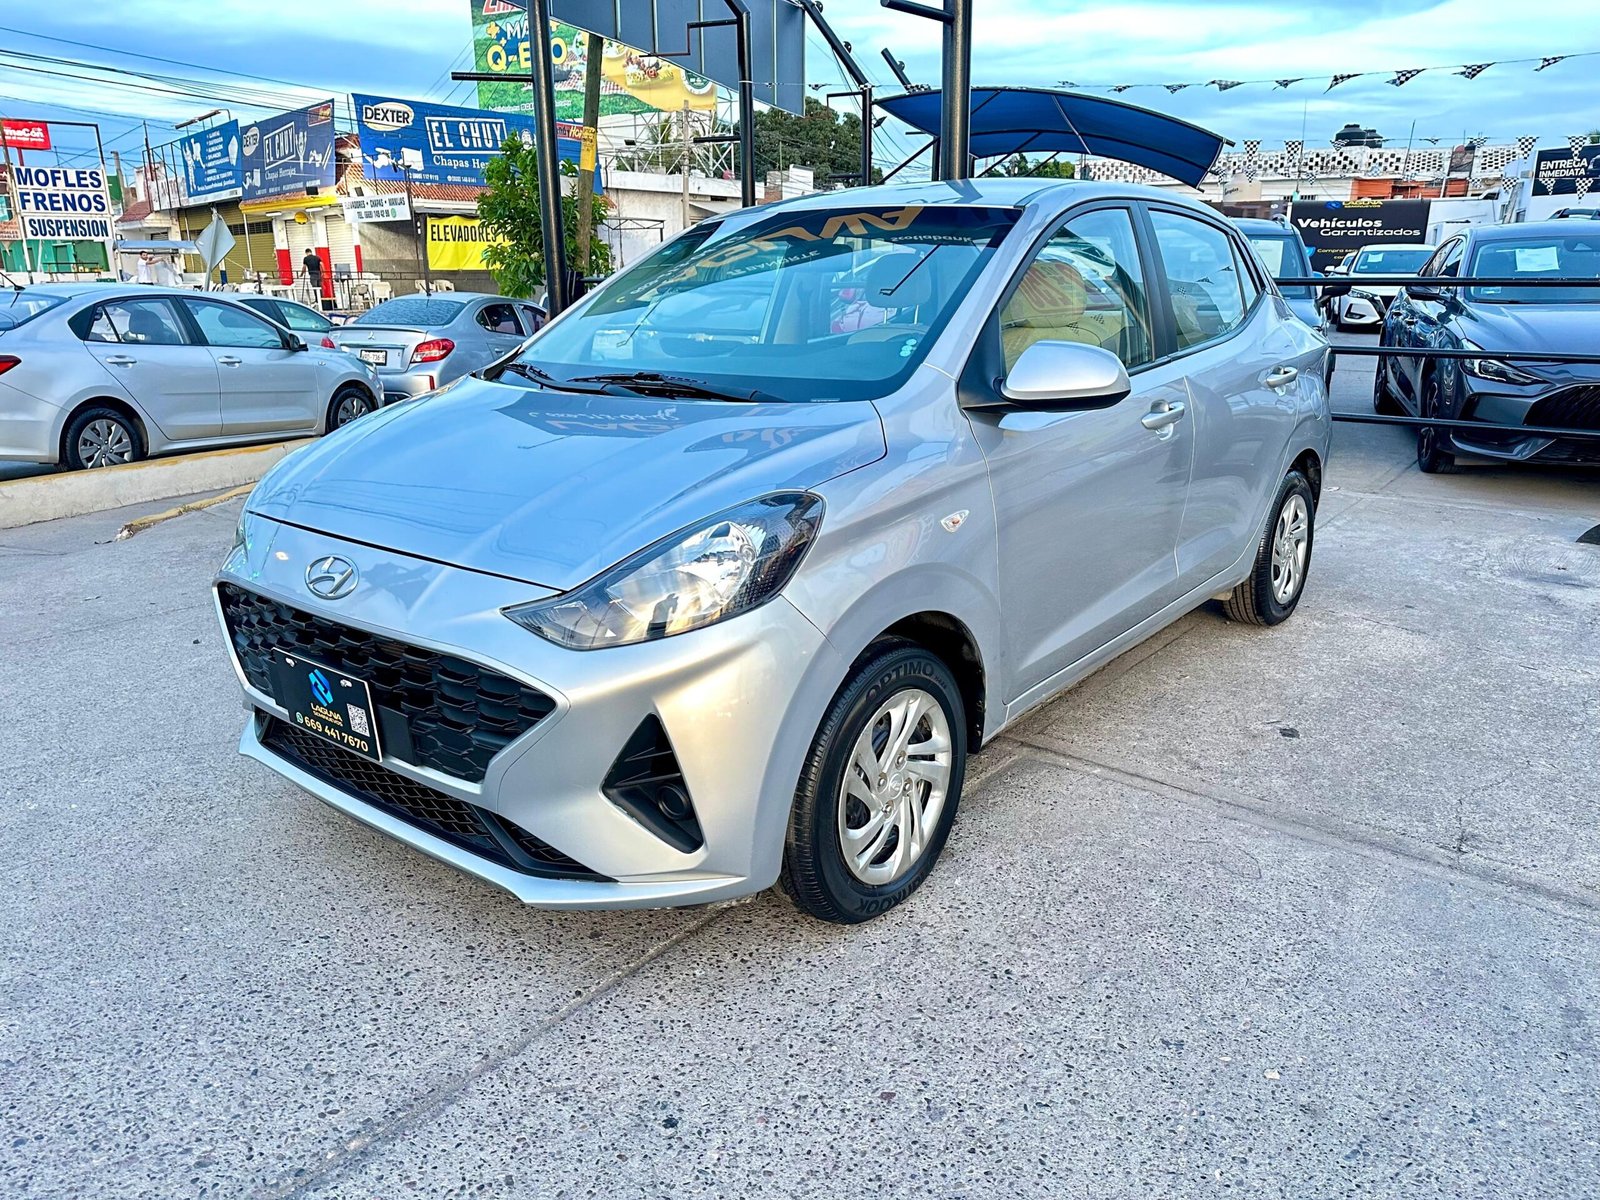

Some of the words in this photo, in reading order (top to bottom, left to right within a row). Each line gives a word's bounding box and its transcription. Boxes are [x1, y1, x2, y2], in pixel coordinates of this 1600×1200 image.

[486, 37, 568, 71] Q-EO
[364, 106, 410, 124] DEXTER
[431, 121, 454, 148] EL
[458, 122, 502, 148] CHUY
[265, 138, 274, 163] EL
[275, 128, 294, 159] CHUY
[433, 155, 469, 169] Chapas
[1540, 158, 1588, 170] ENTREGA
[15, 167, 102, 188] MOFLES
[1539, 168, 1585, 178] INMEDIATA
[19, 191, 106, 212] FRENOS
[28, 218, 109, 237] SUSPENSION
[1297, 218, 1382, 228] Vehículos
[1320, 228, 1421, 237] Garantizados
[431, 224, 497, 242] ELEVADORES
[866, 661, 934, 701] OPTIMO
[304, 716, 322, 732] 669
[324, 725, 340, 741] 441
[341, 732, 369, 752] 7670
